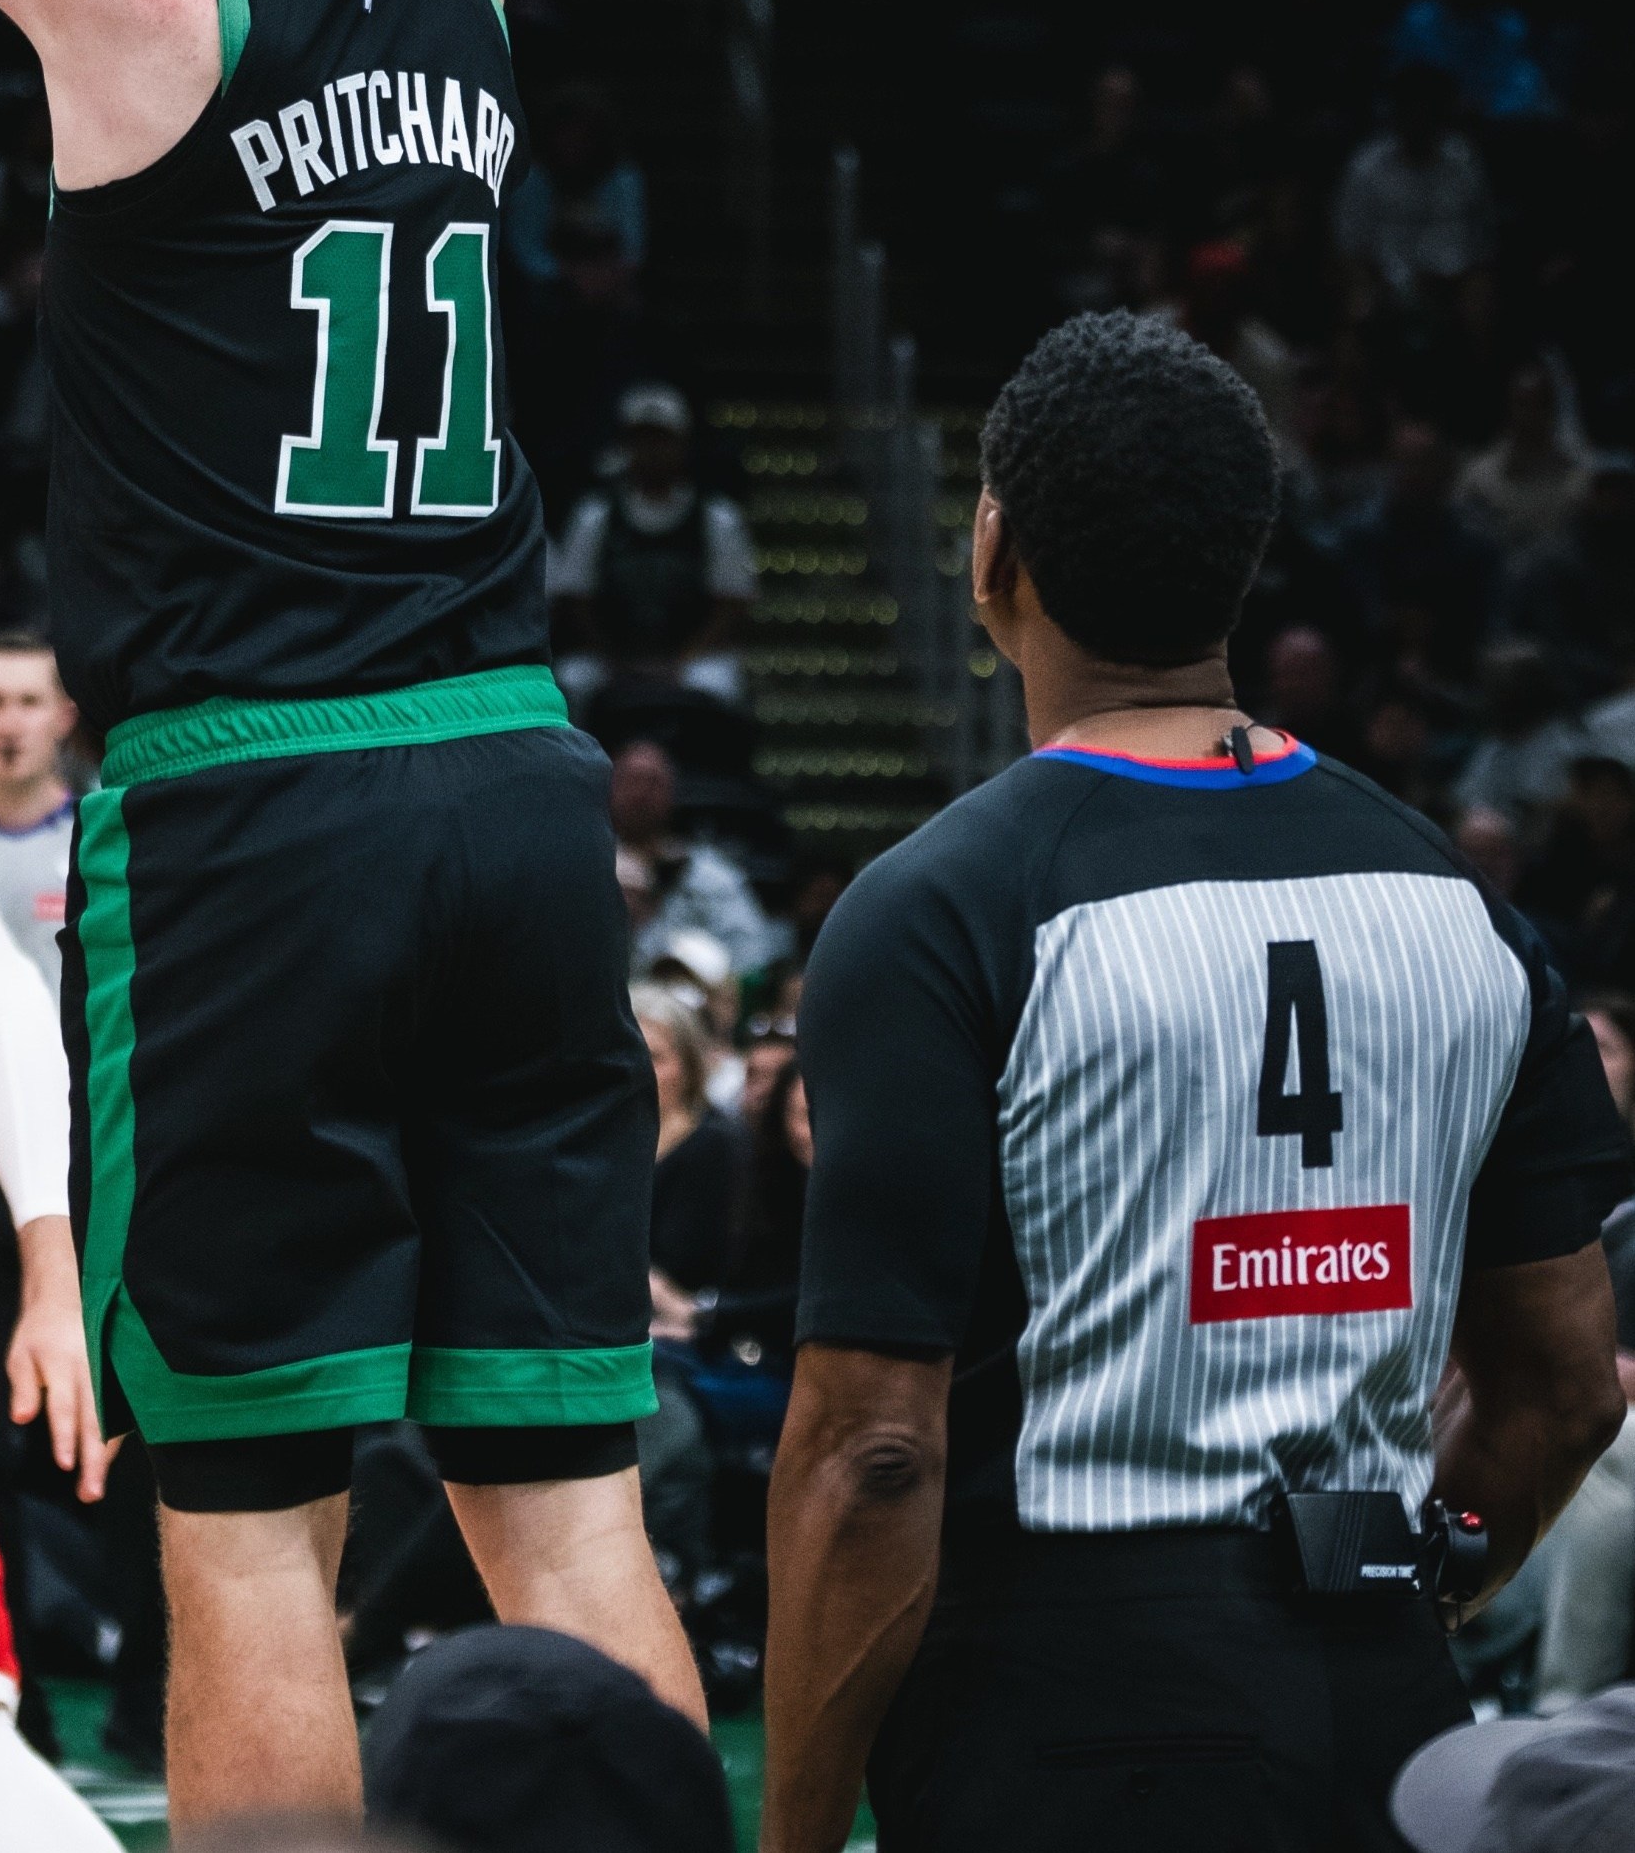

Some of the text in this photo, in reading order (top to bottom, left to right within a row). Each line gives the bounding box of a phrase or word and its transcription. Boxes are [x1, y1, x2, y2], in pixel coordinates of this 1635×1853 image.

[230, 70, 515, 212] PRITCHARD
[274, 220, 501, 518] 11
[1256, 939, 1343, 1169] 4
[1212, 1235, 1390, 1292] Emirates
